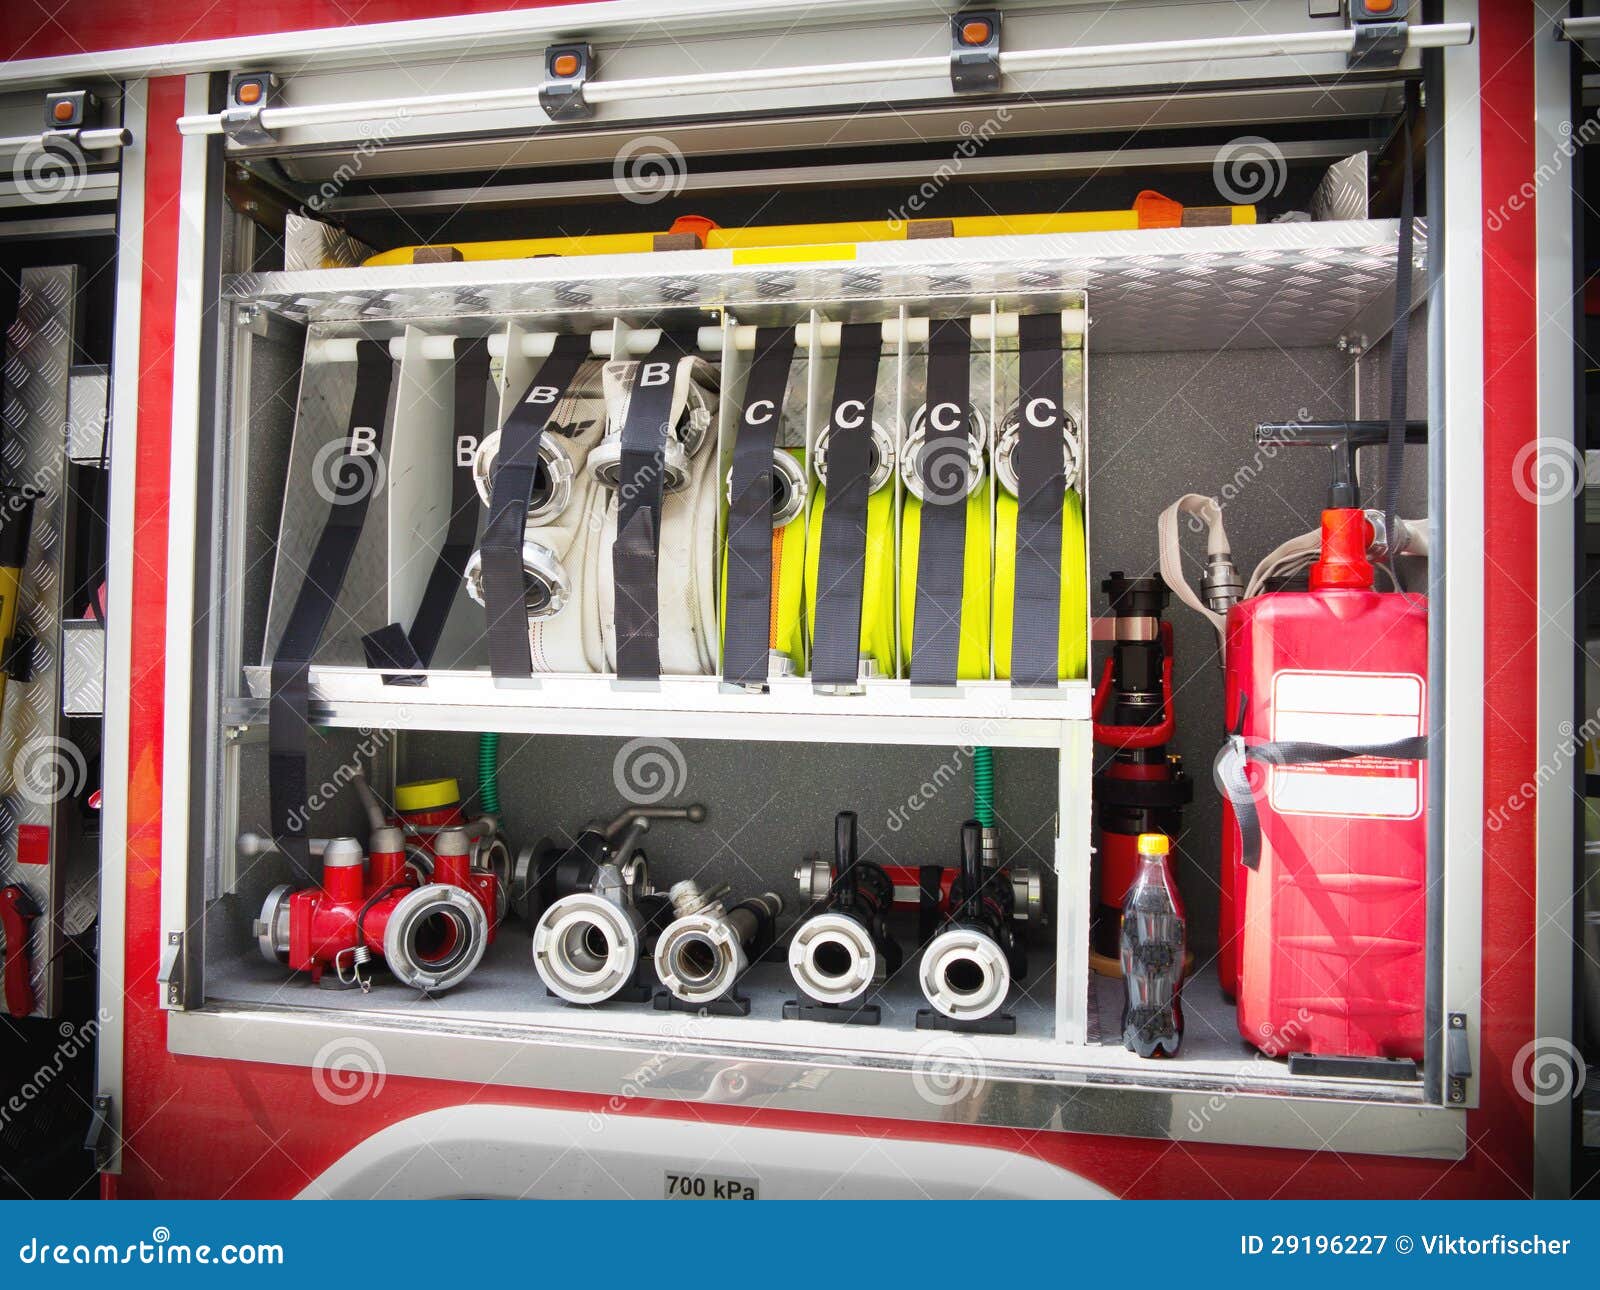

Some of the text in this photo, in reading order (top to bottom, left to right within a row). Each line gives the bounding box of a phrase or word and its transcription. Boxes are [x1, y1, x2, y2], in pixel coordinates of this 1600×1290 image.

[640, 362, 670, 387] B
[524, 386, 559, 404] B
[745, 400, 774, 425] C
[834, 400, 865, 429] C
[930, 402, 961, 431] C
[1025, 398, 1056, 428] C
[350, 426, 376, 456] B
[456, 435, 478, 467] B
[667, 1175, 755, 1200] 700 kPa
